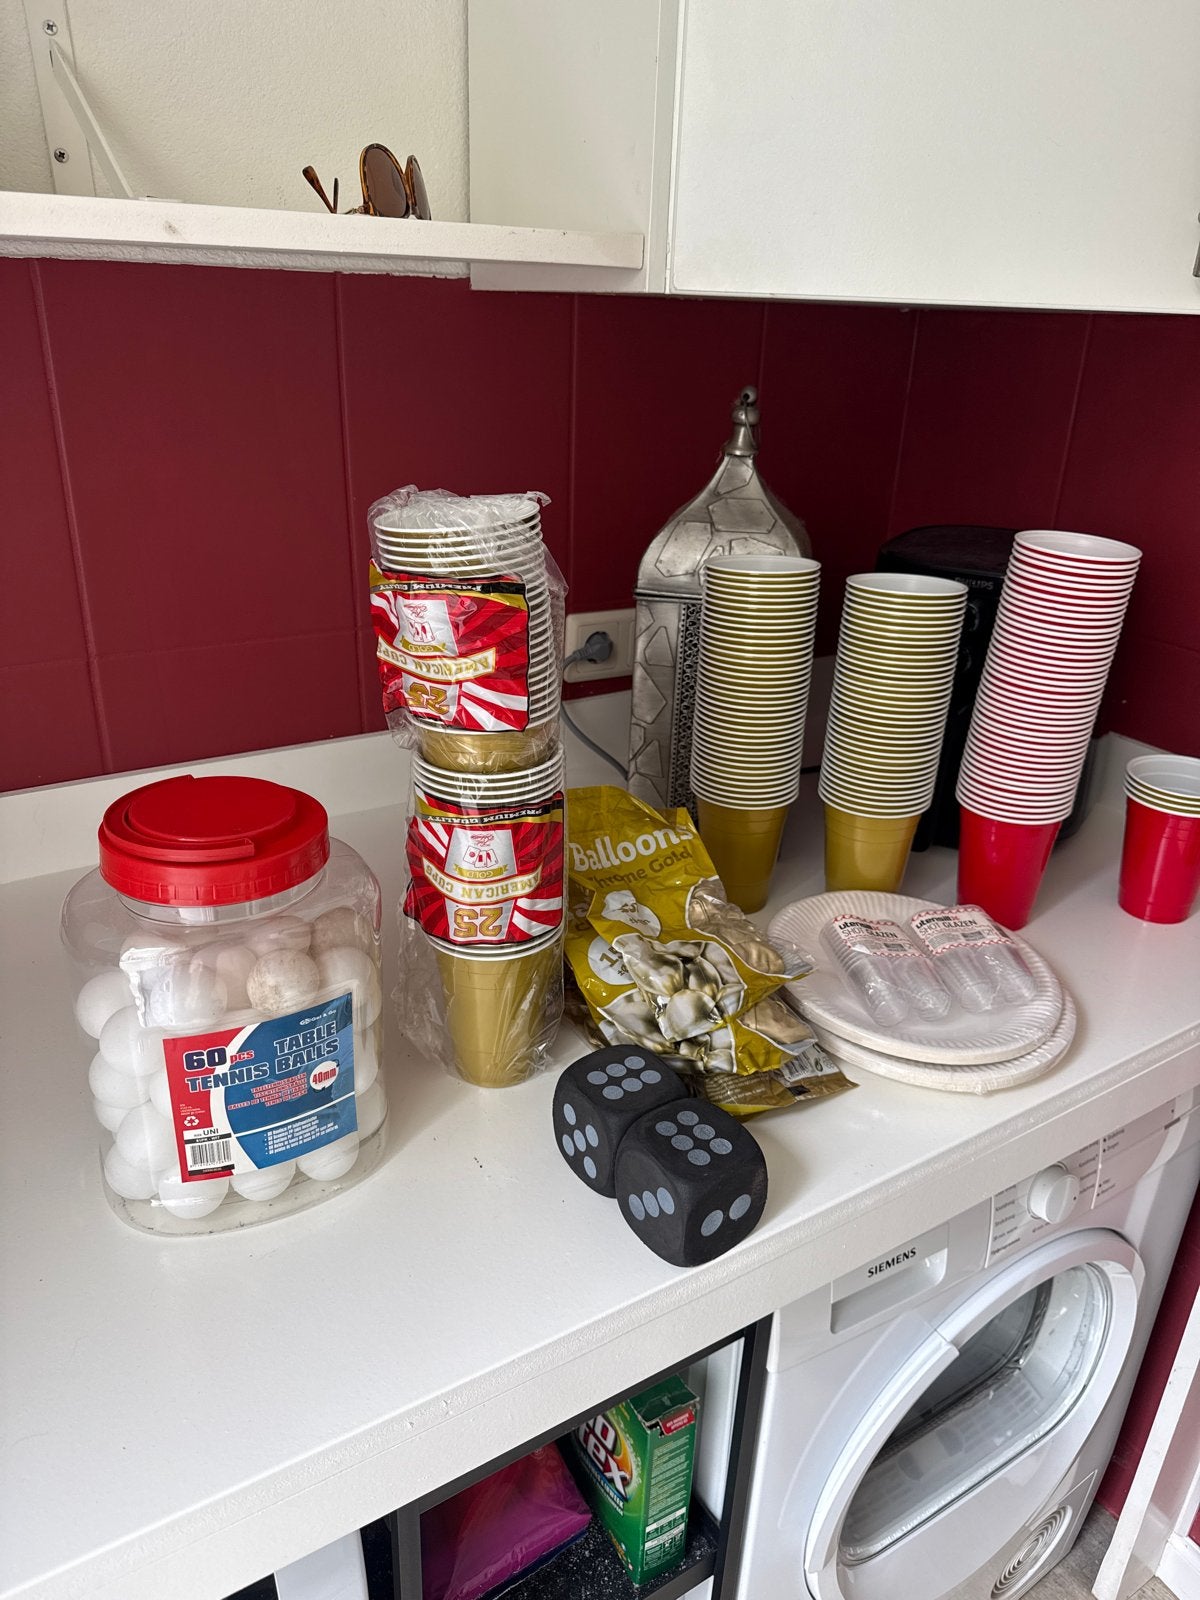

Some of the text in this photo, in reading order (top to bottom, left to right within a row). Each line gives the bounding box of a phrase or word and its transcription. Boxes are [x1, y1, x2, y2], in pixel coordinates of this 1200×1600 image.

[411, 582, 483, 592] PREMIUM
[408, 644, 434, 653] GOLD
[413, 655, 490, 678] AMERICAN
[406, 681, 450, 715] 25
[427, 808, 542, 824] PREMIUM QUALITY
[568, 825, 693, 872] Balloons
[467, 870, 493, 878] GOLD
[590, 845, 693, 889] hrome Gold
[425, 865, 541, 898] AMERICAN CUPS
[453, 906, 503, 938] 25
[918, 919, 977, 936] SHOT GLAZEN
[184, 1020, 337, 1072] 60 pcs TABLE
[186, 1038, 340, 1093] TENNIS BALLS
[312, 1067, 337, 1085] 40mm
[203, 1128, 219, 1136] UNI
[867, 1247, 917, 1279] SIEMENS
